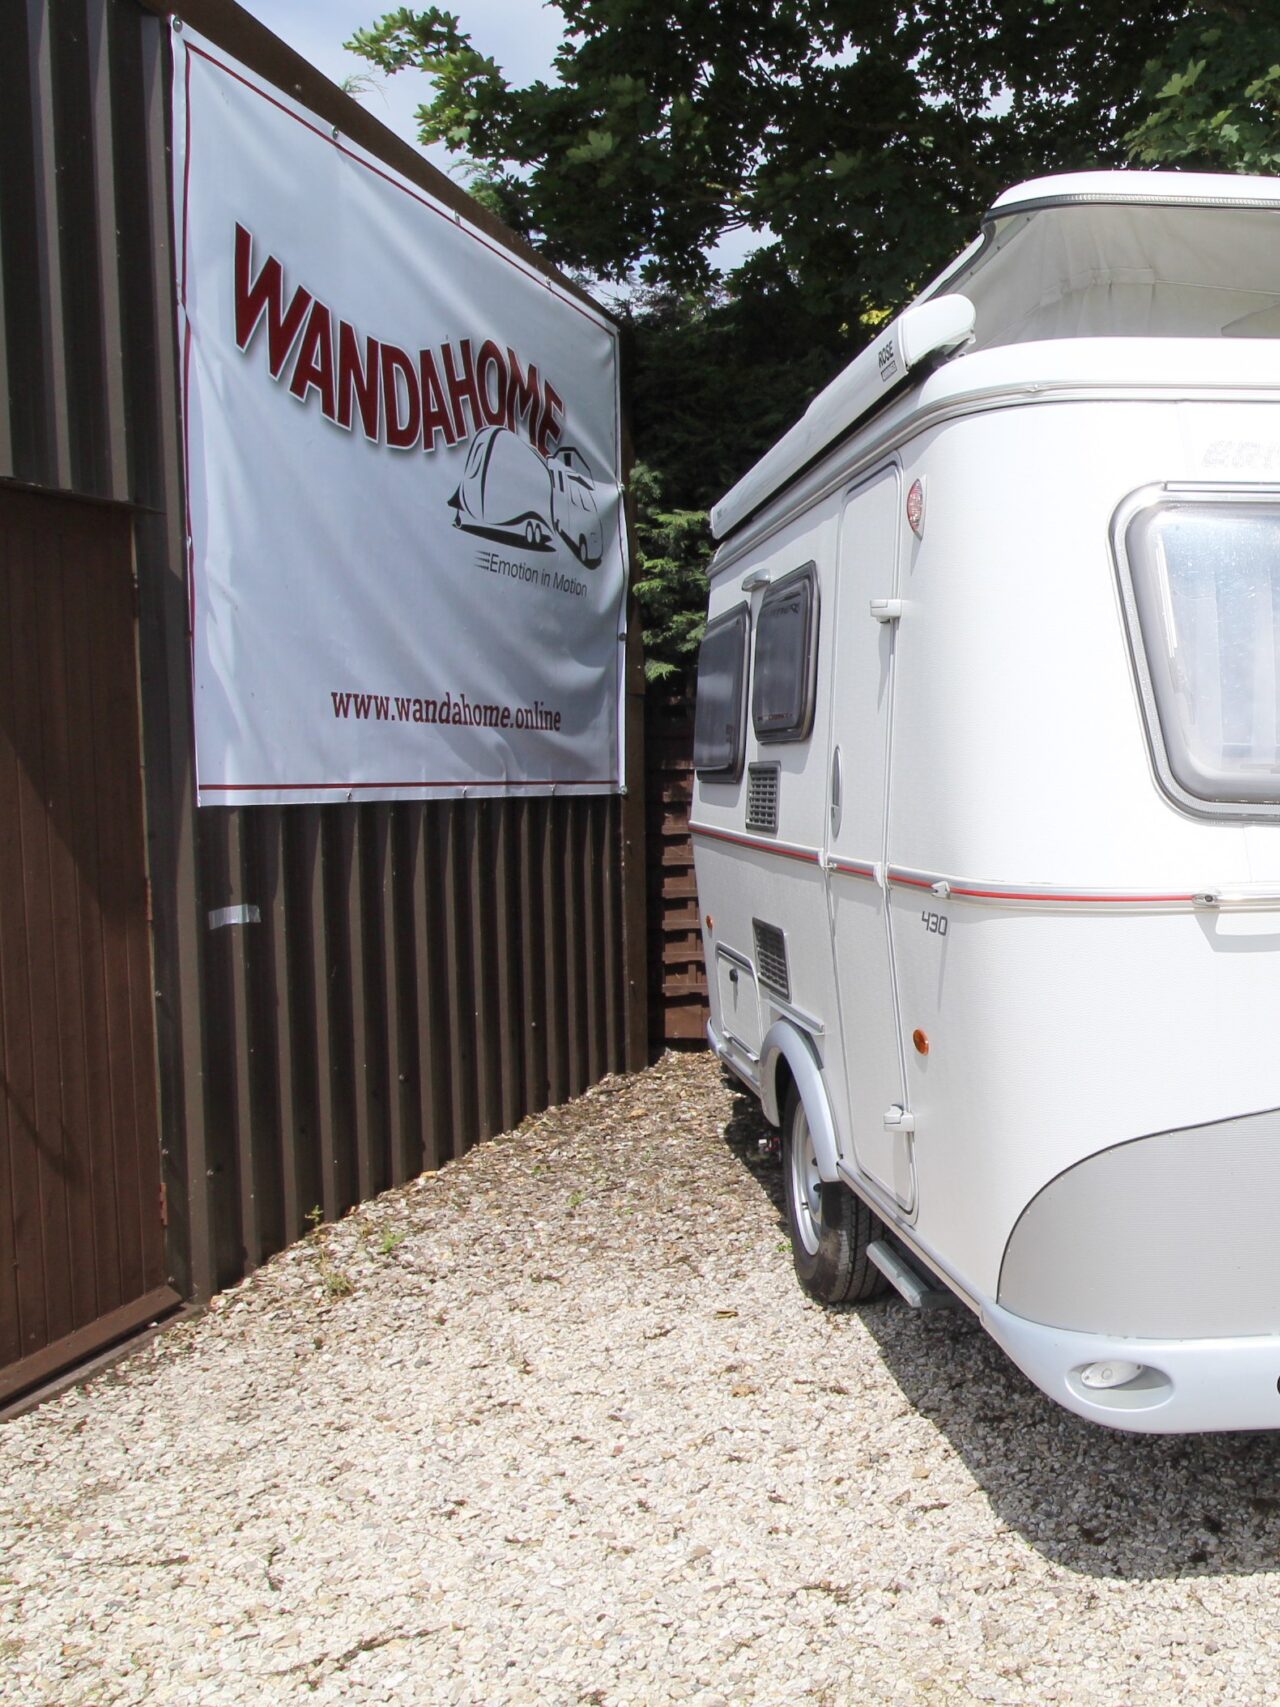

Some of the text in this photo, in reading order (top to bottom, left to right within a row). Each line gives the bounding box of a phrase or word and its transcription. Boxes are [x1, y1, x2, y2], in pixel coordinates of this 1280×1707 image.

[235, 221, 564, 460] WANDAHOME
[490, 553, 588, 598] Emotion in Motion
[331, 692, 561, 731] www.wandahome.online
[921, 911, 948, 936] 430
